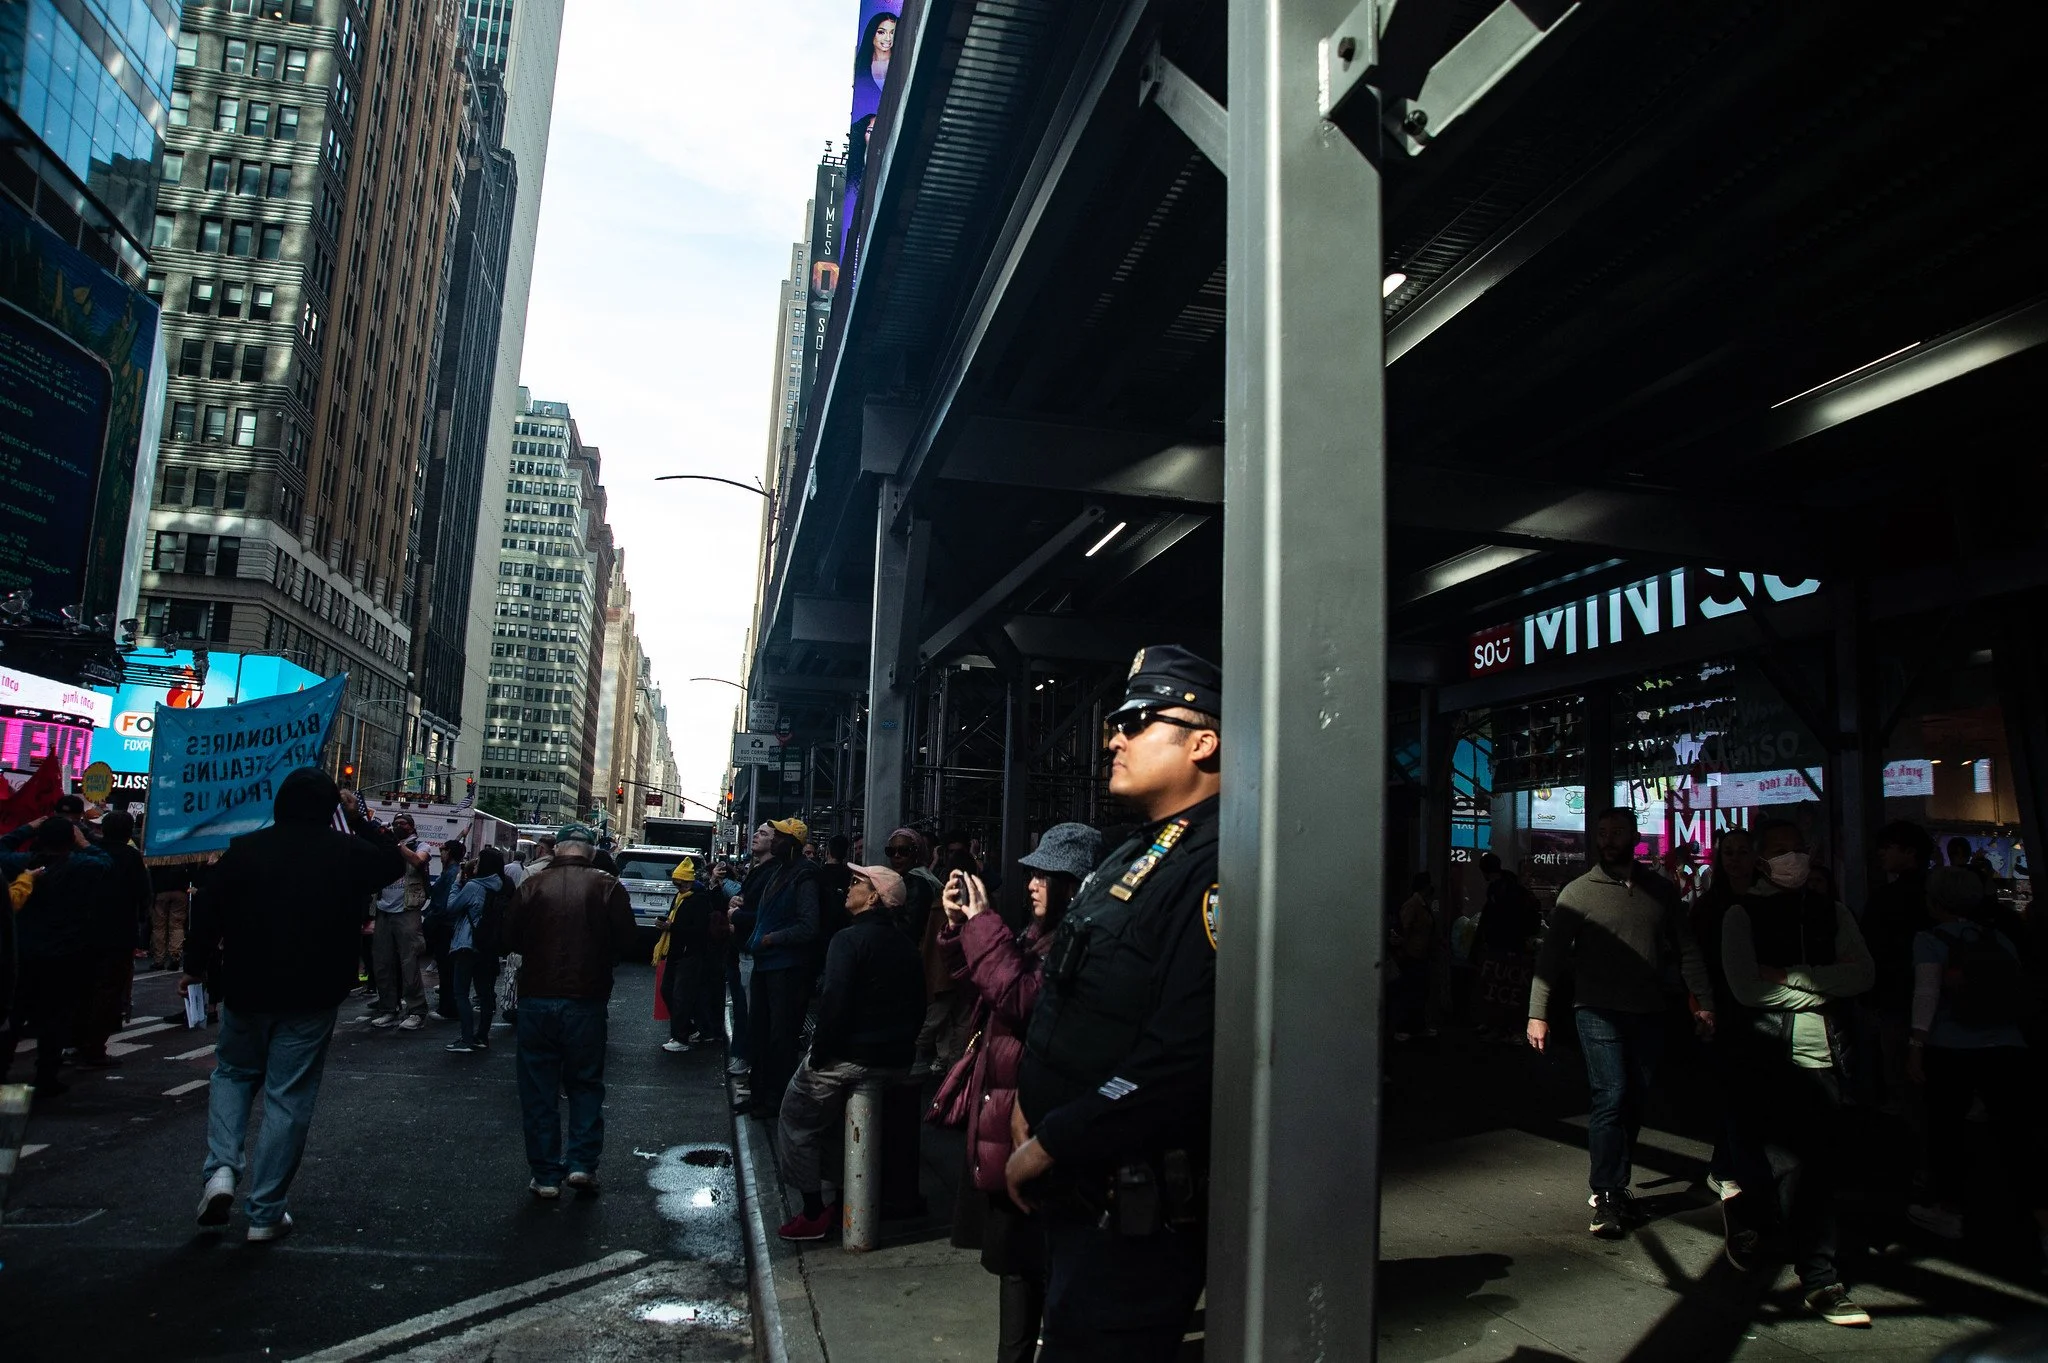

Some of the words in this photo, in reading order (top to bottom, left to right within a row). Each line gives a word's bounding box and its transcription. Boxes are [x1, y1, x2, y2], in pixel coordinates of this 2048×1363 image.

[824, 173, 837, 256] TIMES
[122, 715, 154, 732] FO
[124, 739, 150, 751] FOXP
[723, 828, 735, 837] 25
[1480, 958, 1531, 985] FUCK
[1484, 982, 1522, 1006] ICE
